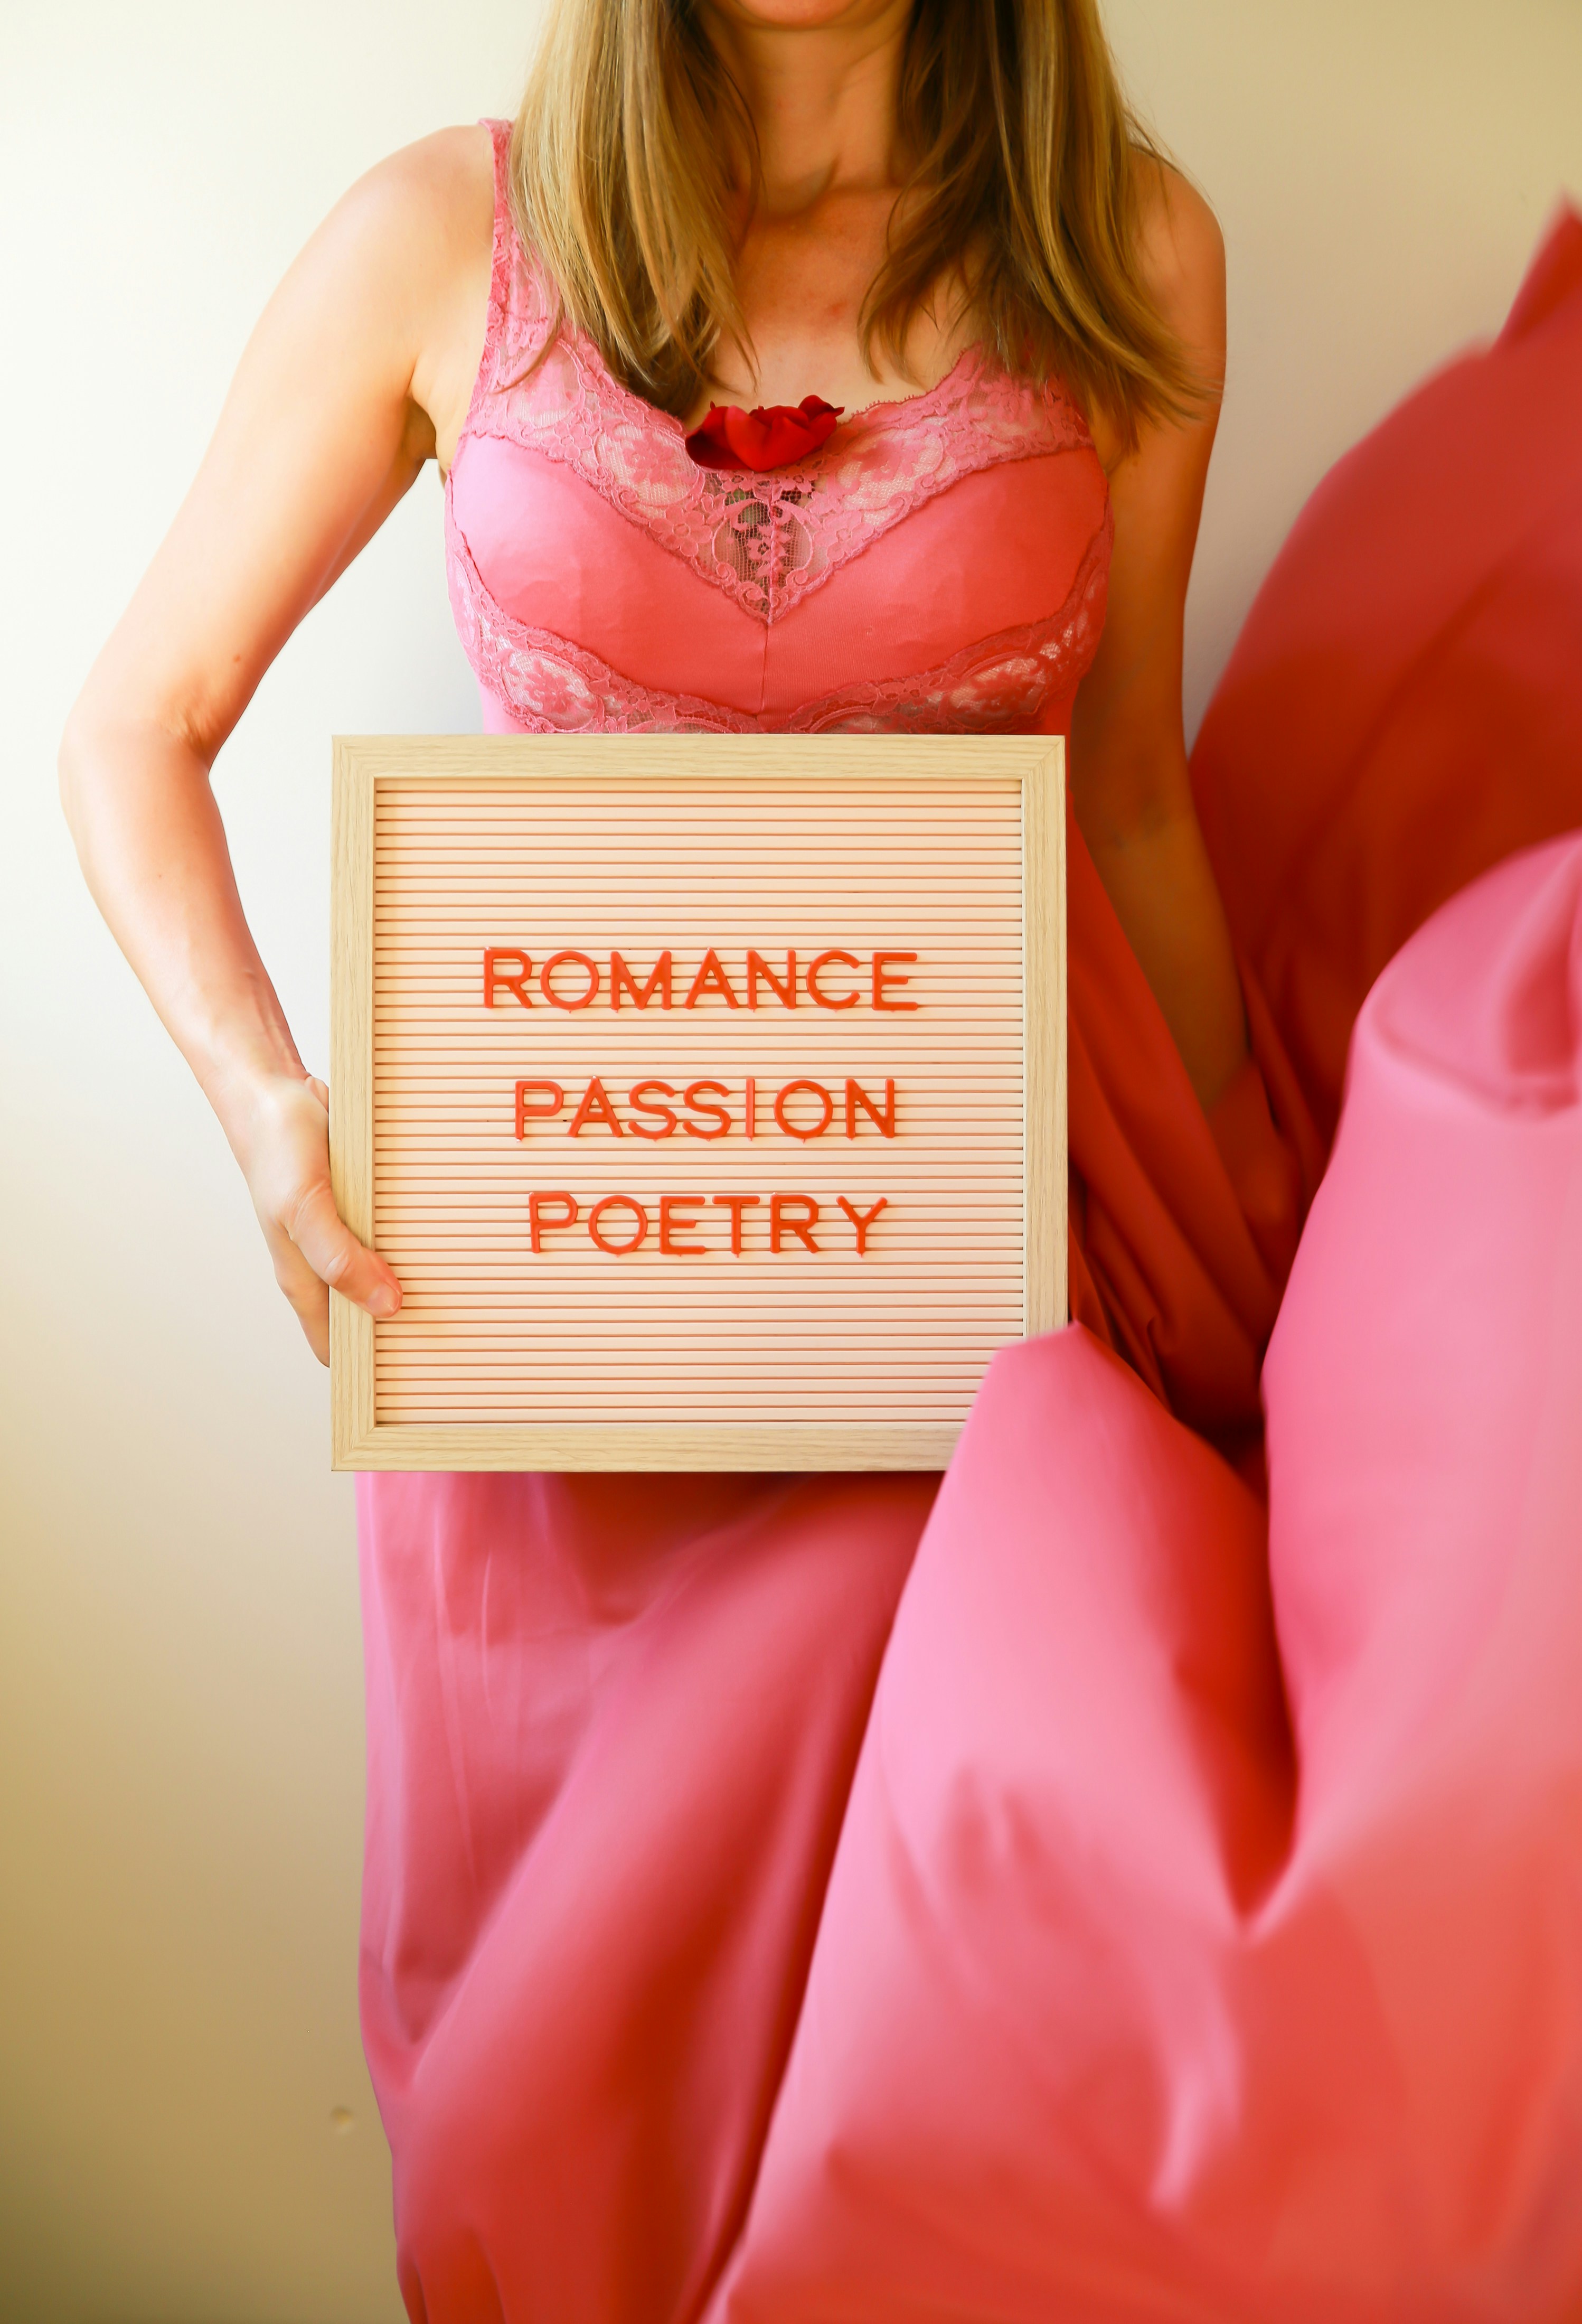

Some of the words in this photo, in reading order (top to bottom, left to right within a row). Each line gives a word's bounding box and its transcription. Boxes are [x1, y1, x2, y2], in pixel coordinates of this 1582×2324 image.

[483, 948, 918, 1011] ROMANCE
[515, 1077, 896, 1140] PASSION
[529, 1192, 888, 1255] POETRY
